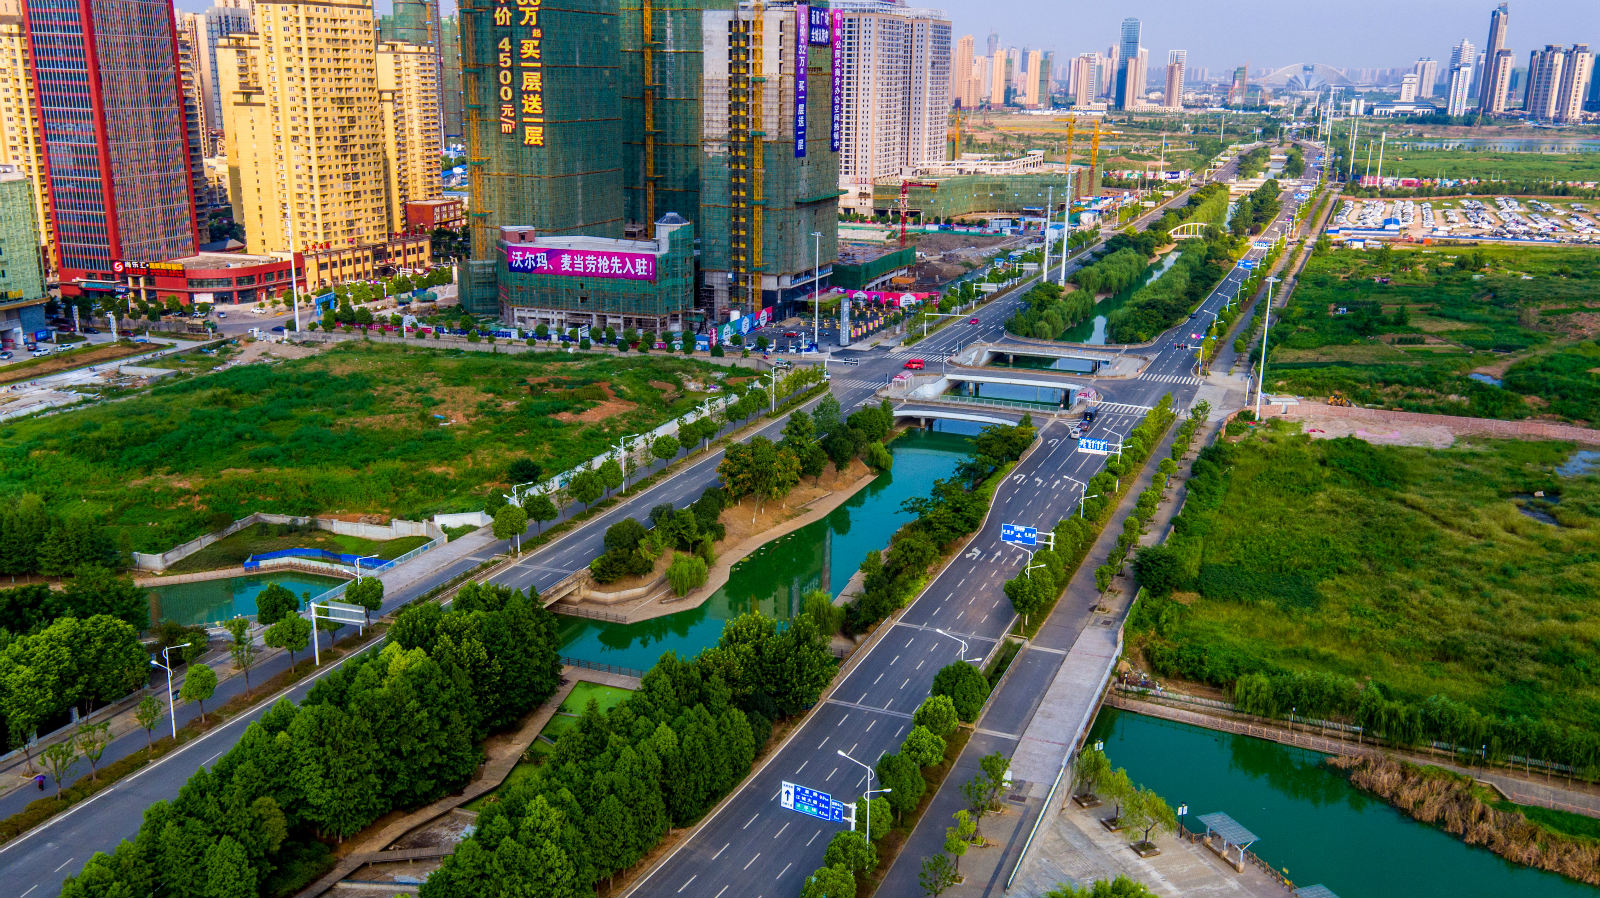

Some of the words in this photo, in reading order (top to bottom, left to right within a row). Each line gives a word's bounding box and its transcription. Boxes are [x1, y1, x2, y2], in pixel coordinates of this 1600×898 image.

[511, 250, 653, 276] 沃尔玛、麦当劳抢先入驻！
